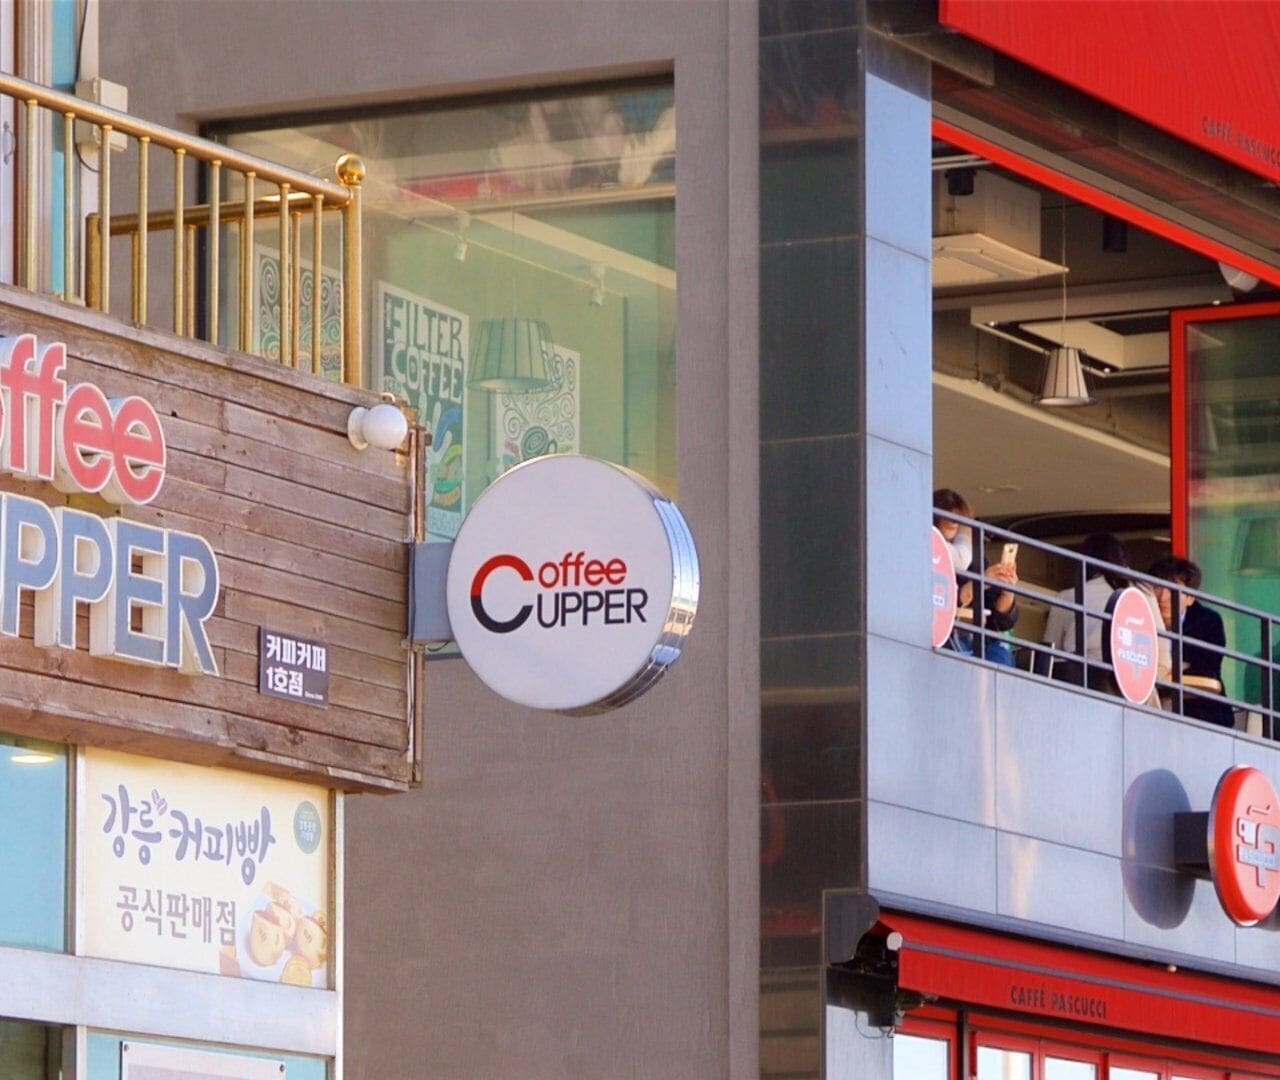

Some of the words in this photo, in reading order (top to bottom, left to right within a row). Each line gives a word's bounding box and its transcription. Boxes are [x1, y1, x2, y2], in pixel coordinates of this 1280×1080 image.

[389, 289, 464, 359] FILTER
[391, 340, 464, 399] COFFEE
[470, 551, 627, 602] Coffee
[265, 634, 328, 673] 커피커퍼
[265, 666, 304, 697] 1호점
[101, 783, 163, 866] 강릉
[168, 805, 277, 886] 커피빵
[115, 884, 237, 947] 공식판매점
[1050, 989, 1107, 1019] PASCUCCI
